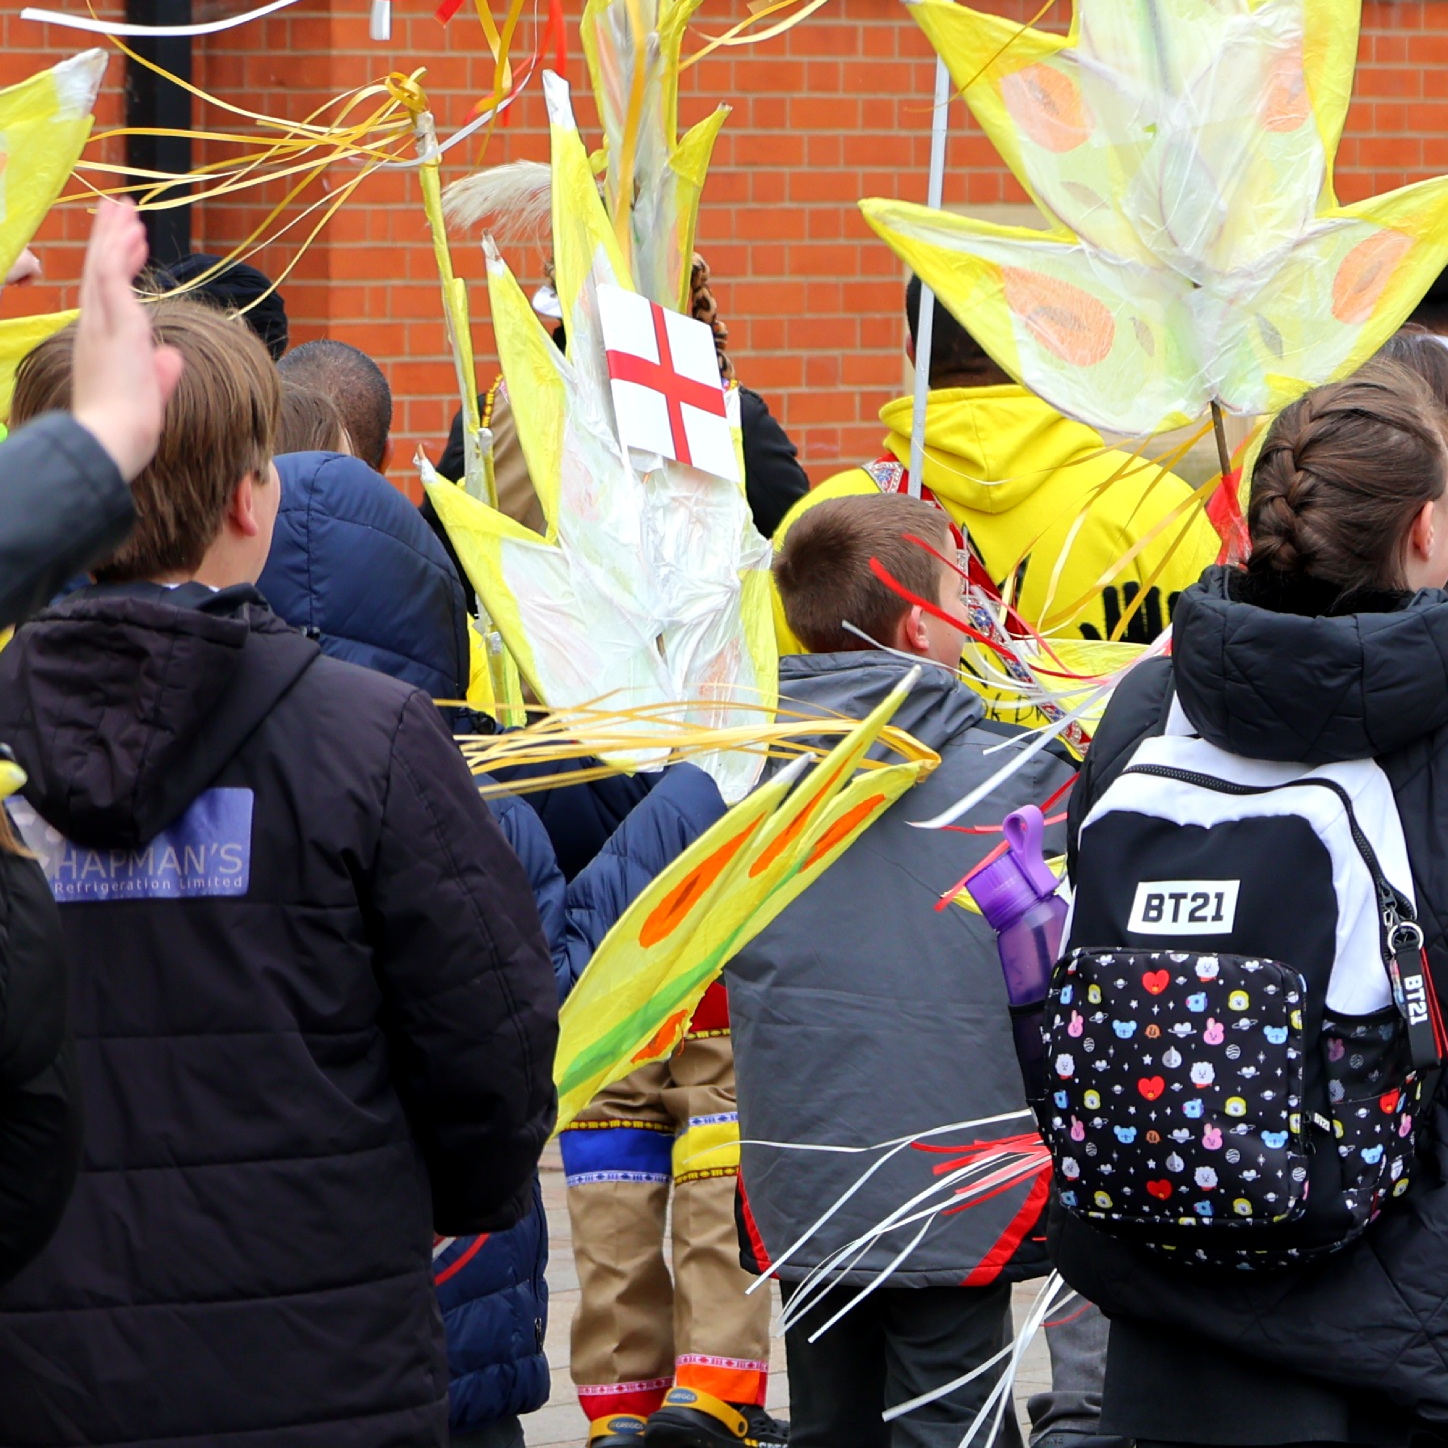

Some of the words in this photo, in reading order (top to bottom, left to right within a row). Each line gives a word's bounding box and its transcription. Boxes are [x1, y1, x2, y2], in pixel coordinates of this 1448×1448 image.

[54, 880, 171, 895] Refrigeration
[179, 875, 243, 890] Limited
[1142, 892, 1225, 923] BT21
[1404, 974, 1428, 1026] BT21
